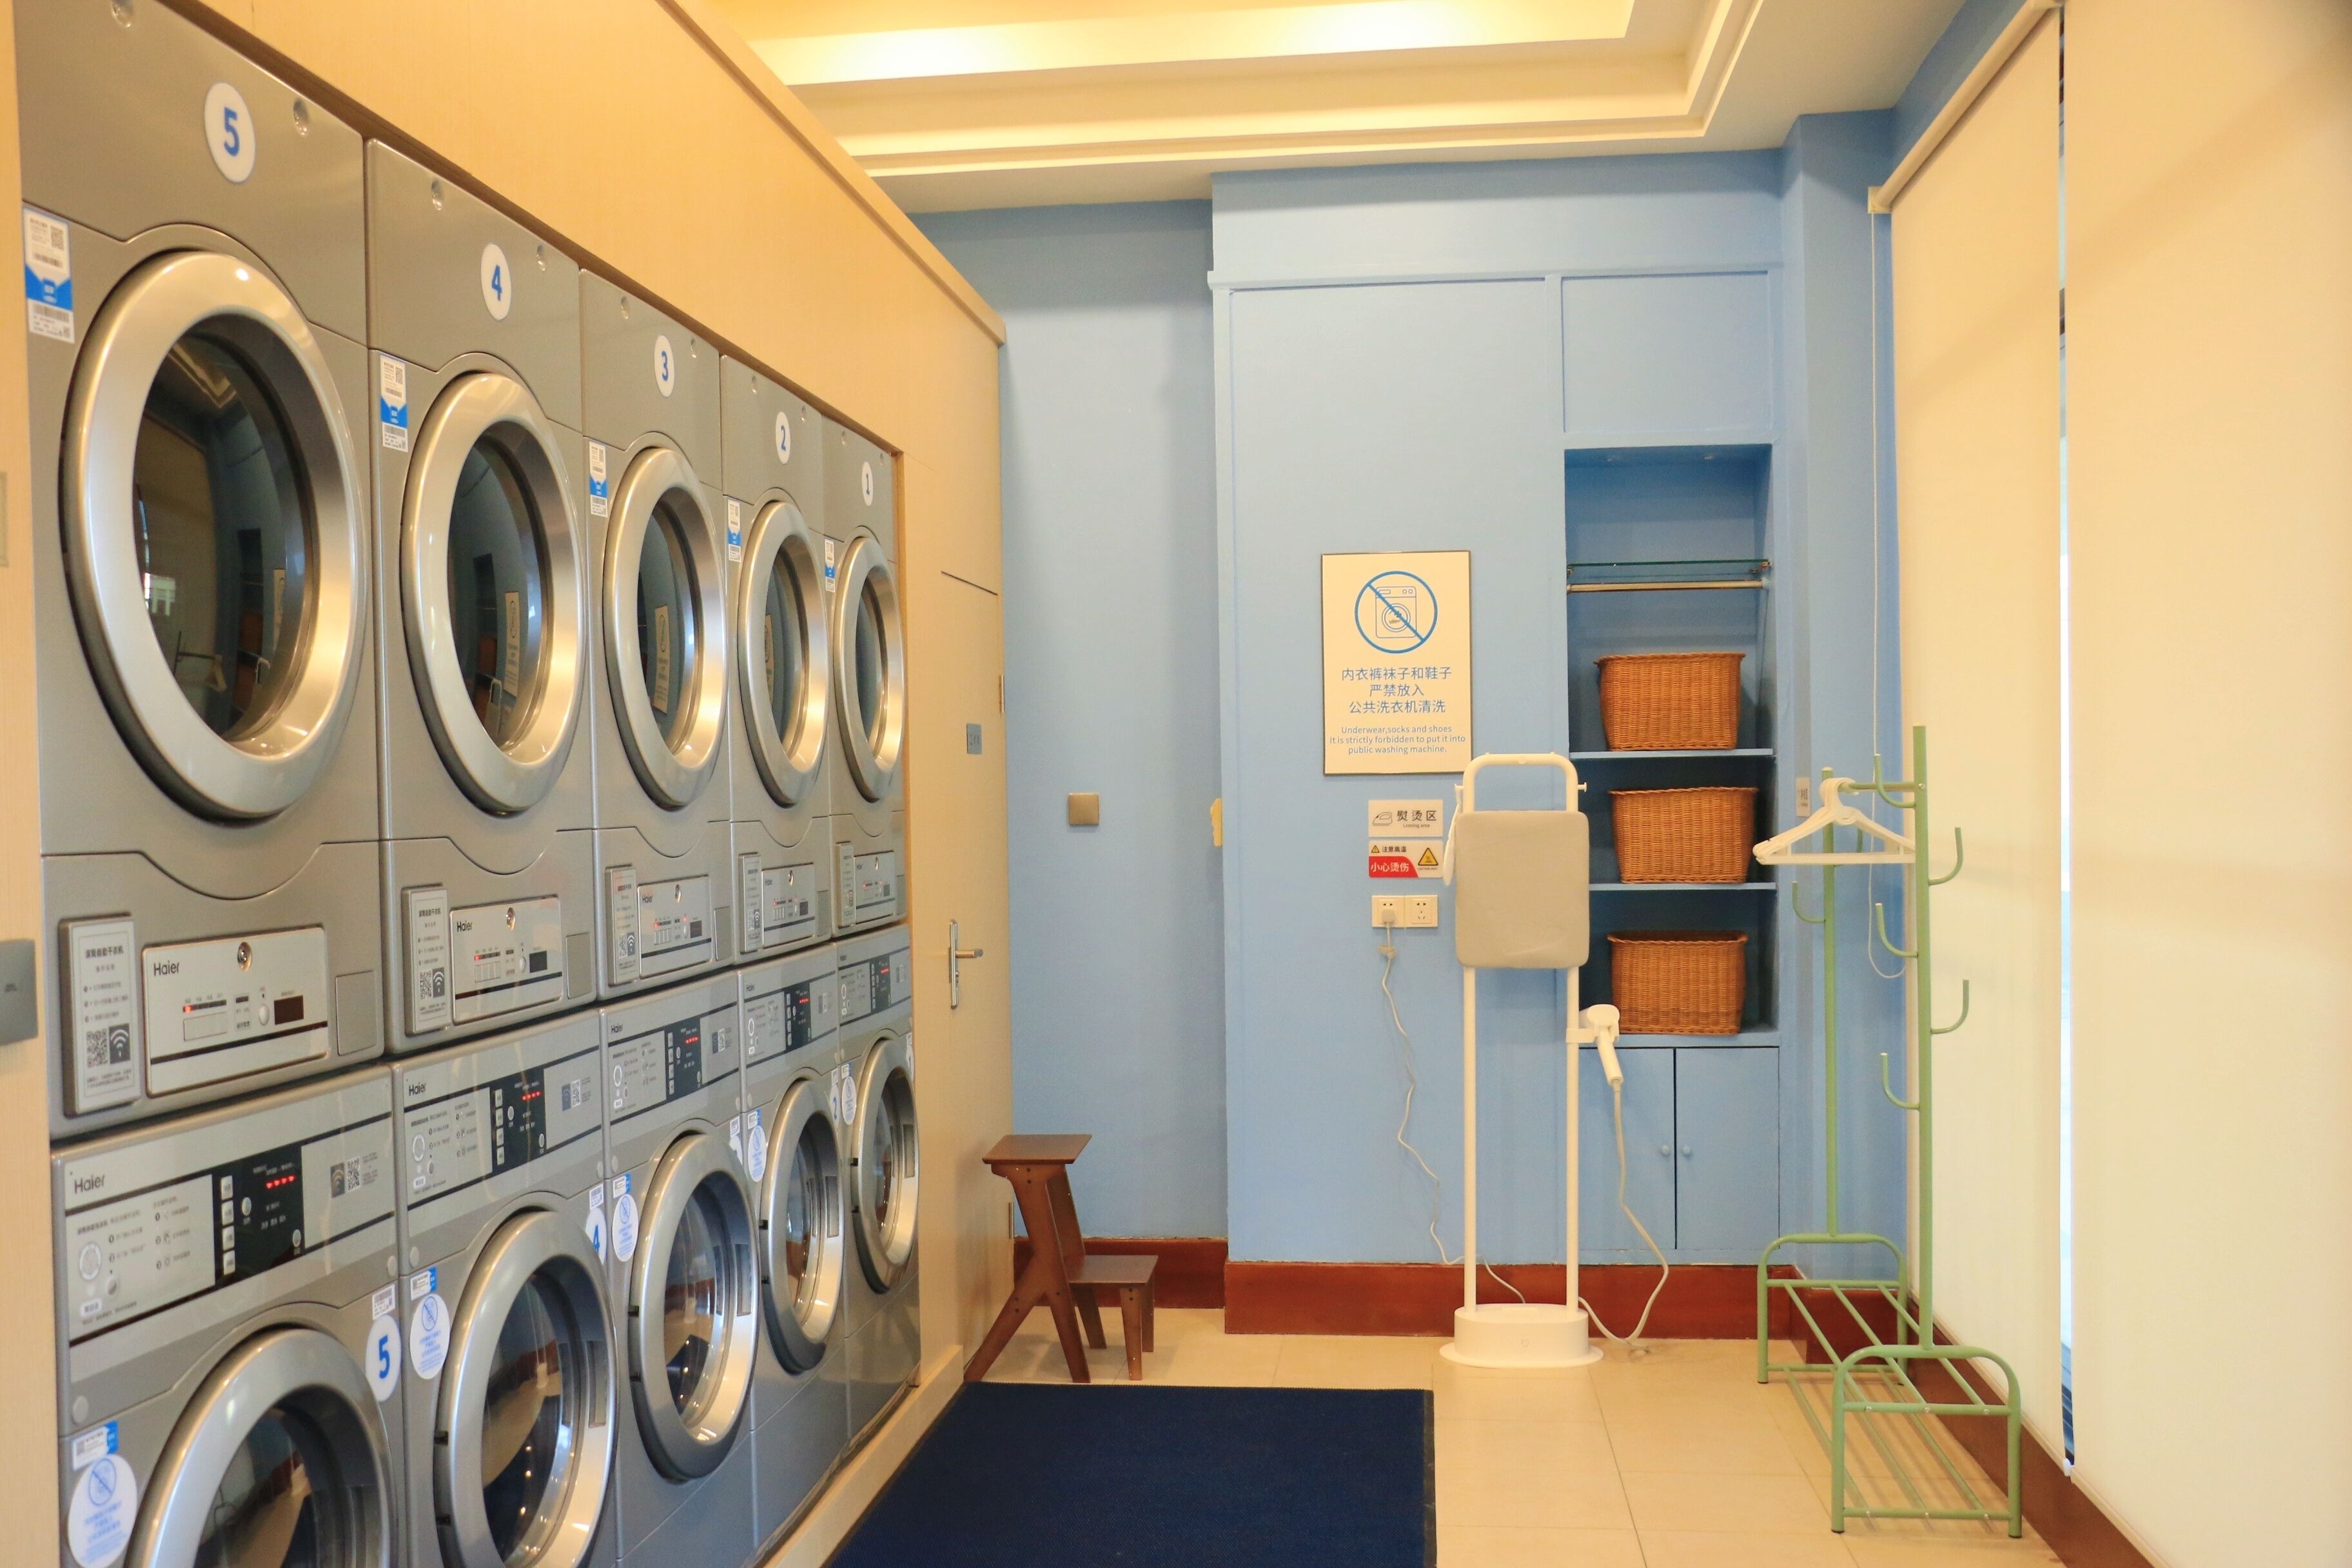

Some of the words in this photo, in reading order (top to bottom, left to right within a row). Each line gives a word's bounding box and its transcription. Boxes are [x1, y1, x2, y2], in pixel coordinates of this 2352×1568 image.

[223, 107, 240, 156] 5
[491, 265, 502, 301] 4
[661, 351, 669, 381] 3
[780, 425, 787, 451] 2
[865, 473, 871, 495] 1
[1341, 666, 1452, 681] 内衣裤袜子和鞋子
[1369, 683, 1424, 697] 严禁放入
[1349, 700, 1446, 714] 公共洗衣机清洗
[1341, 725, 1410, 734] Underwear,socks
[1346, 736, 1373, 745] strictly
[1375, 735, 1415, 743] forbidden
[1426, 736, 1440, 745] put
[1348, 745, 1373, 755] public
[1375, 745, 1409, 755] washing
[1410, 745, 1447, 753] machine.
[1397, 810, 1437, 821] 熨烫区
[1371, 862, 1409, 872] 小心烫伤
[642, 894, 653, 903] Haier
[456, 919, 473, 933] Haier
[153, 960, 180, 977] Haier
[611, 1023, 623, 1034] Haier
[409, 1083, 426, 1096] Haier
[833, 1096, 838, 1121] 2
[74, 1174, 105, 1195] Haier
[593, 1224, 600, 1253] 4
[378, 1334, 391, 1379] 5
